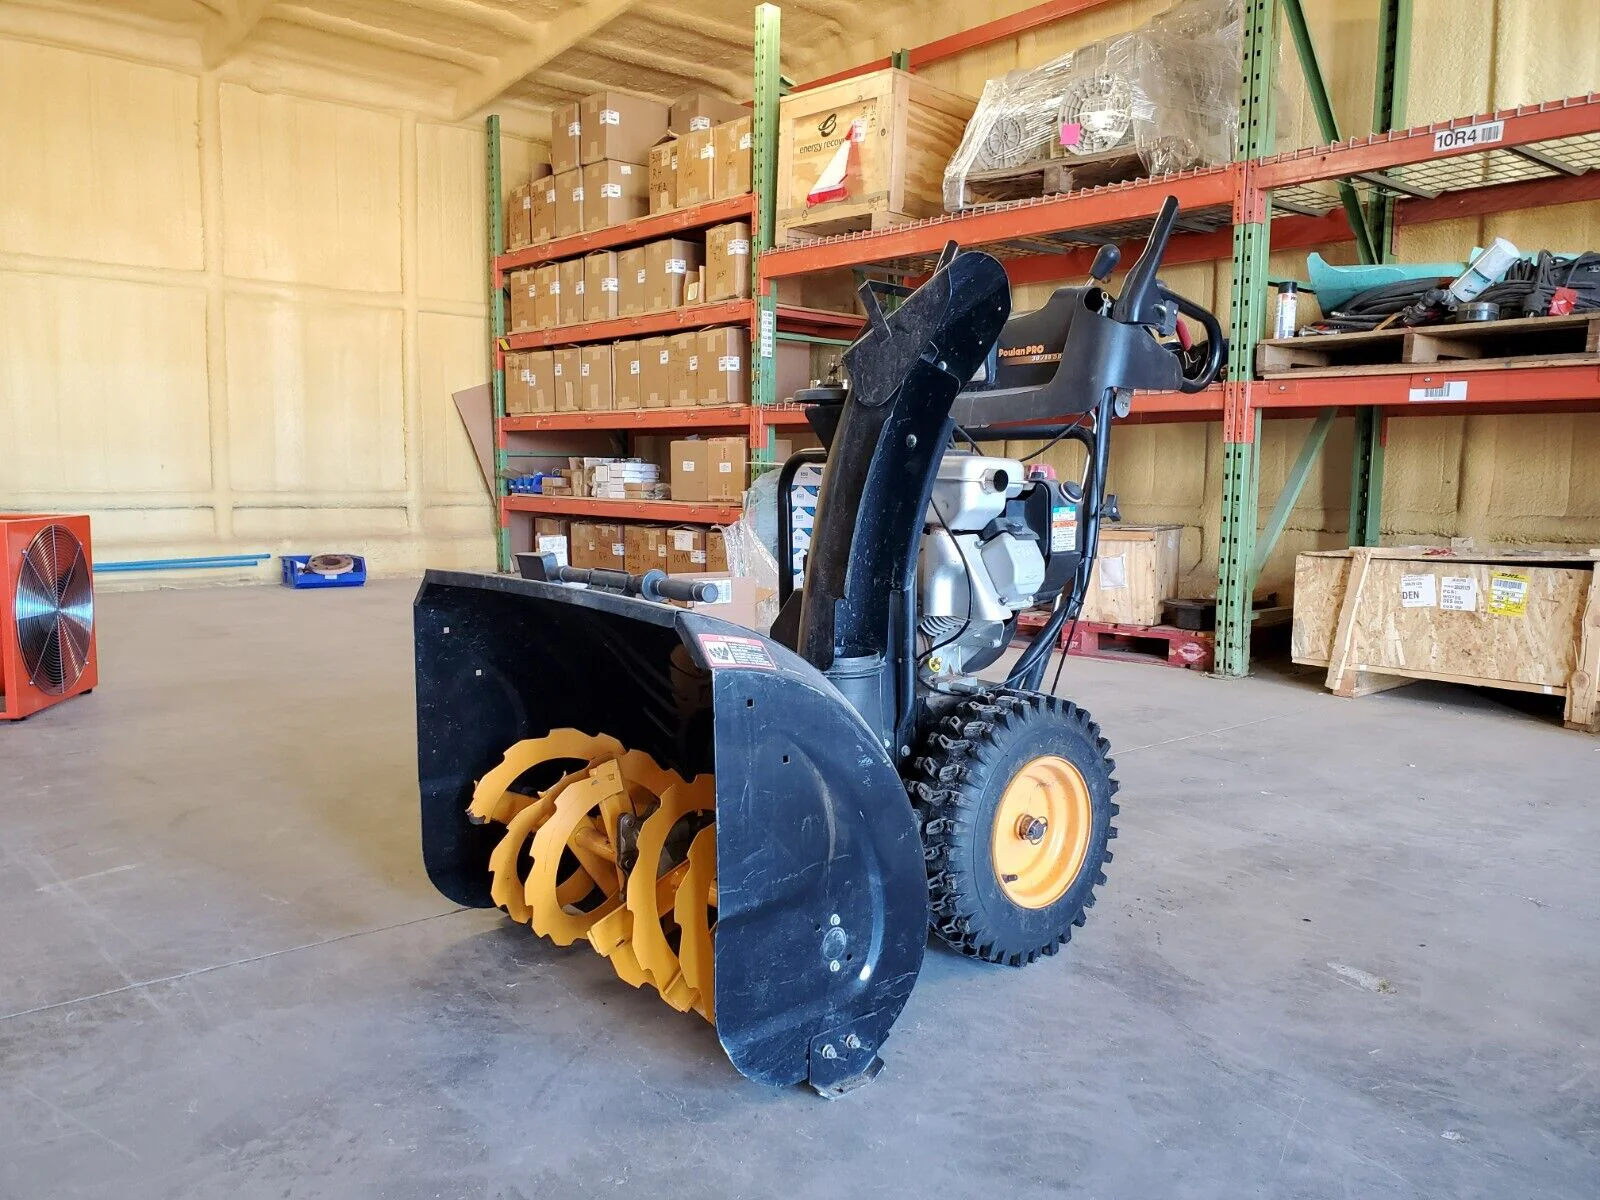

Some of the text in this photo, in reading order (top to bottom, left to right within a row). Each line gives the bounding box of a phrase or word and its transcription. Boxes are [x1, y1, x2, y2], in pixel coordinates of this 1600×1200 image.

[1437, 129, 1477, 148] 10R4
[799, 143, 823, 154] energy
[998, 348, 1025, 357] Poulan
[1026, 345, 1044, 354] PRO
[1402, 590, 1420, 600] DEN
